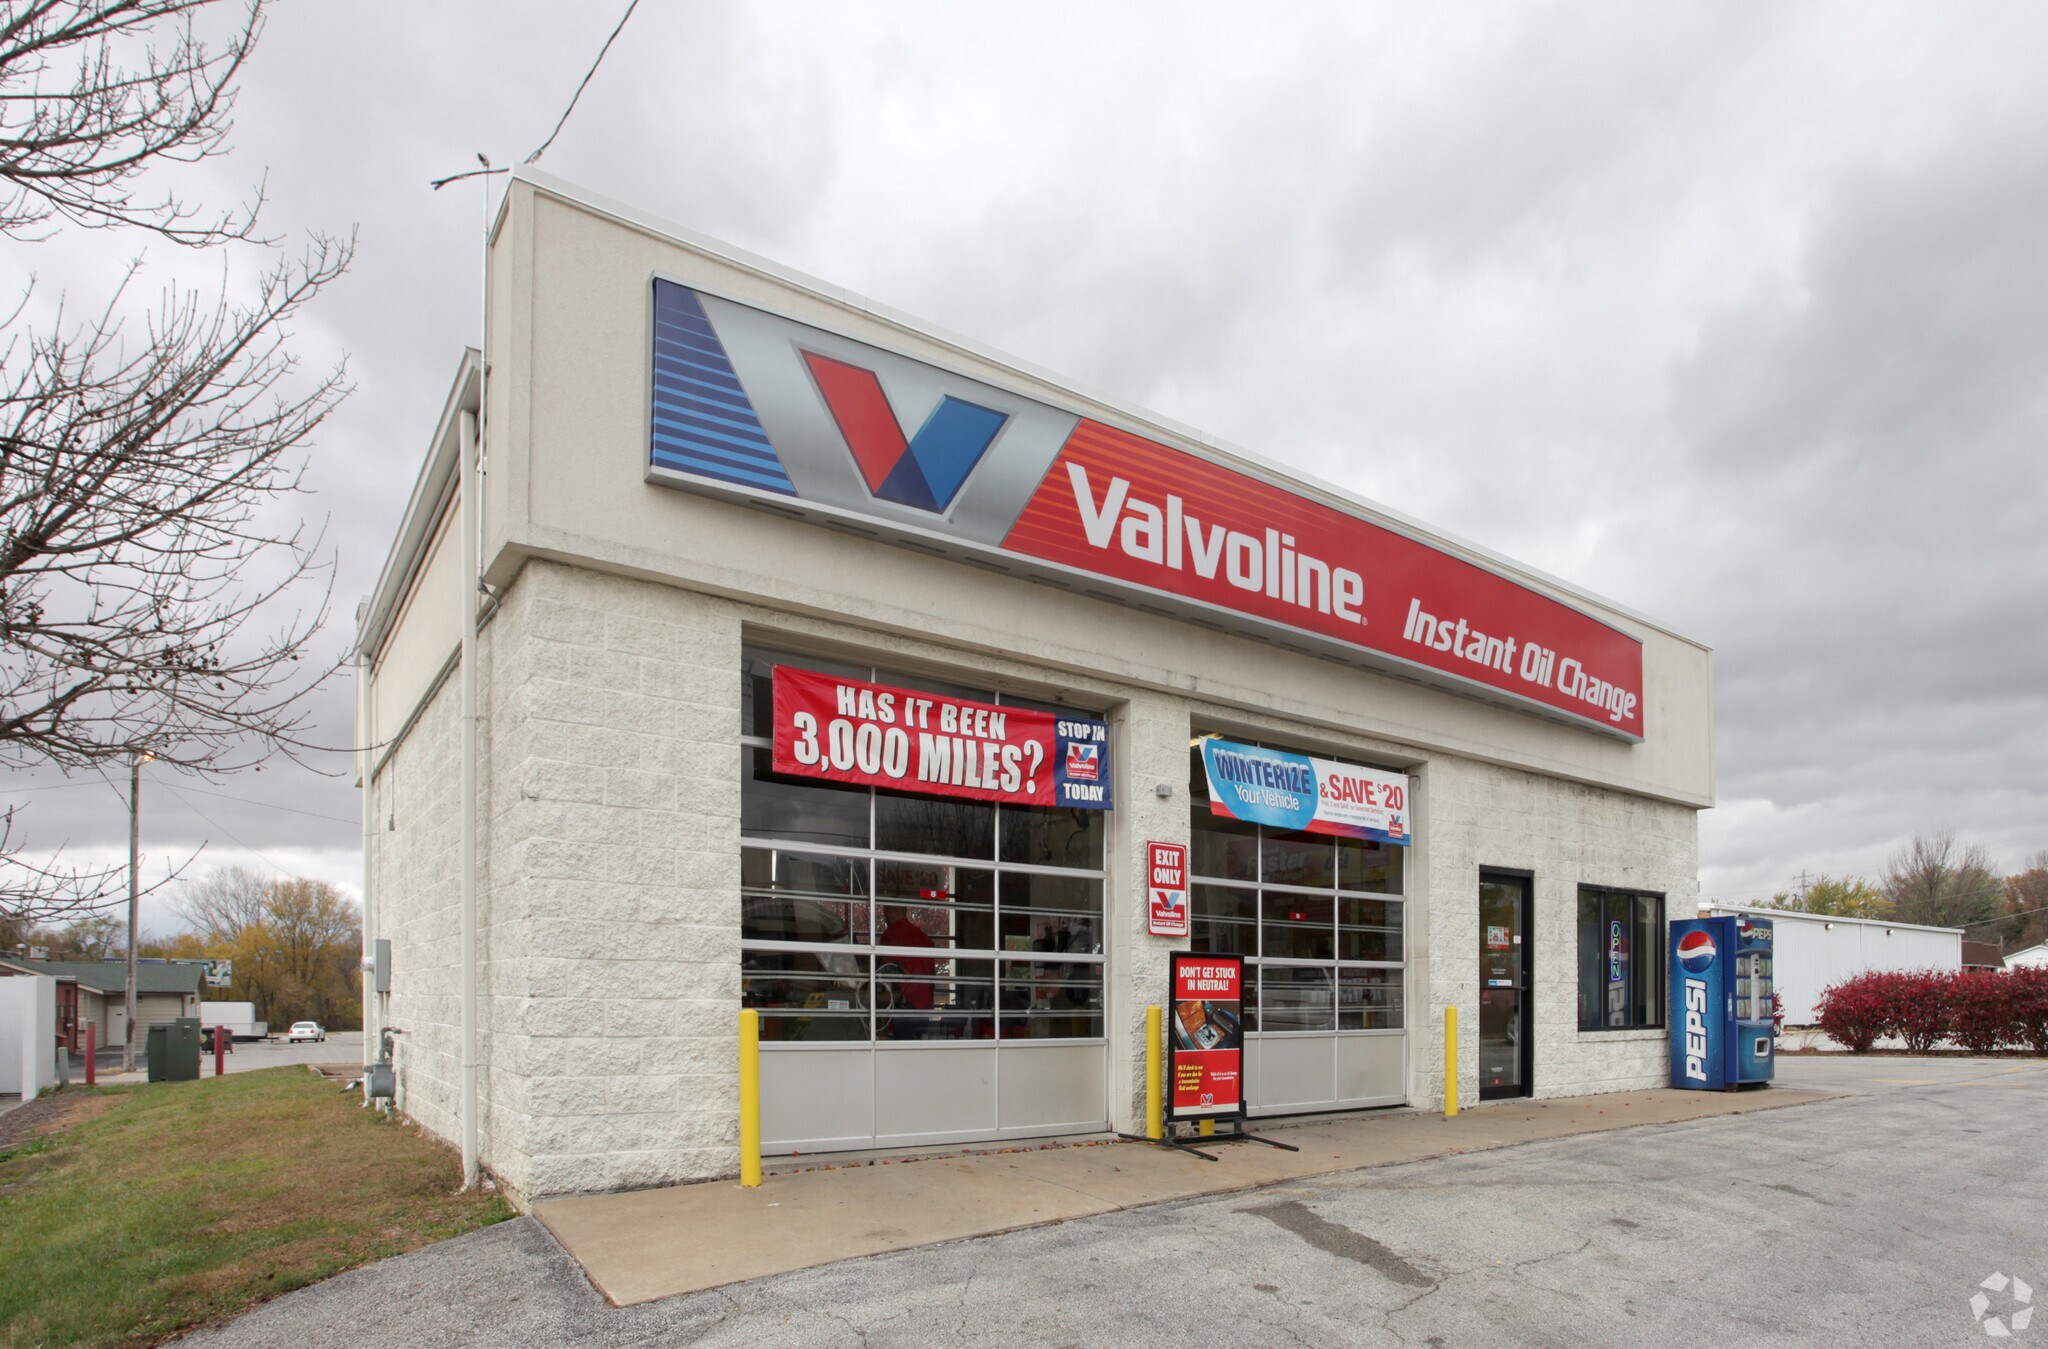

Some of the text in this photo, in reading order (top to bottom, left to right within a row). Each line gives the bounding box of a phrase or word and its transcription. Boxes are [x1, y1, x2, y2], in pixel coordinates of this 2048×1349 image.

[1065, 461, 1364, 625] Valvoline
[1403, 597, 1637, 723] Instant Oil Change
[836, 684, 1007, 741] HAS IT BEEN
[1058, 720, 1105, 741] STOP IN
[793, 711, 1044, 795] 3,000 MILES?
[1212, 748, 1312, 795] WINTERIZE
[1063, 783, 1104, 802] TODAY
[1234, 784, 1300, 811] Your Vehicle
[1329, 774, 1377, 806] SAVE
[1377, 783, 1404, 811] $20
[1155, 849, 1179, 867] EXIT
[1154, 867, 1181, 885] ONLY
[1155, 910, 1181, 918] Valvoline
[1752, 927, 1772, 940] PEPS
[1612, 923, 1620, 977] OPEN
[1180, 966, 1236, 978] DON'T GET STUCK
[1187, 979, 1229, 991] IN NEUTRAL!
[1685, 977, 1708, 1082] PEPSI
